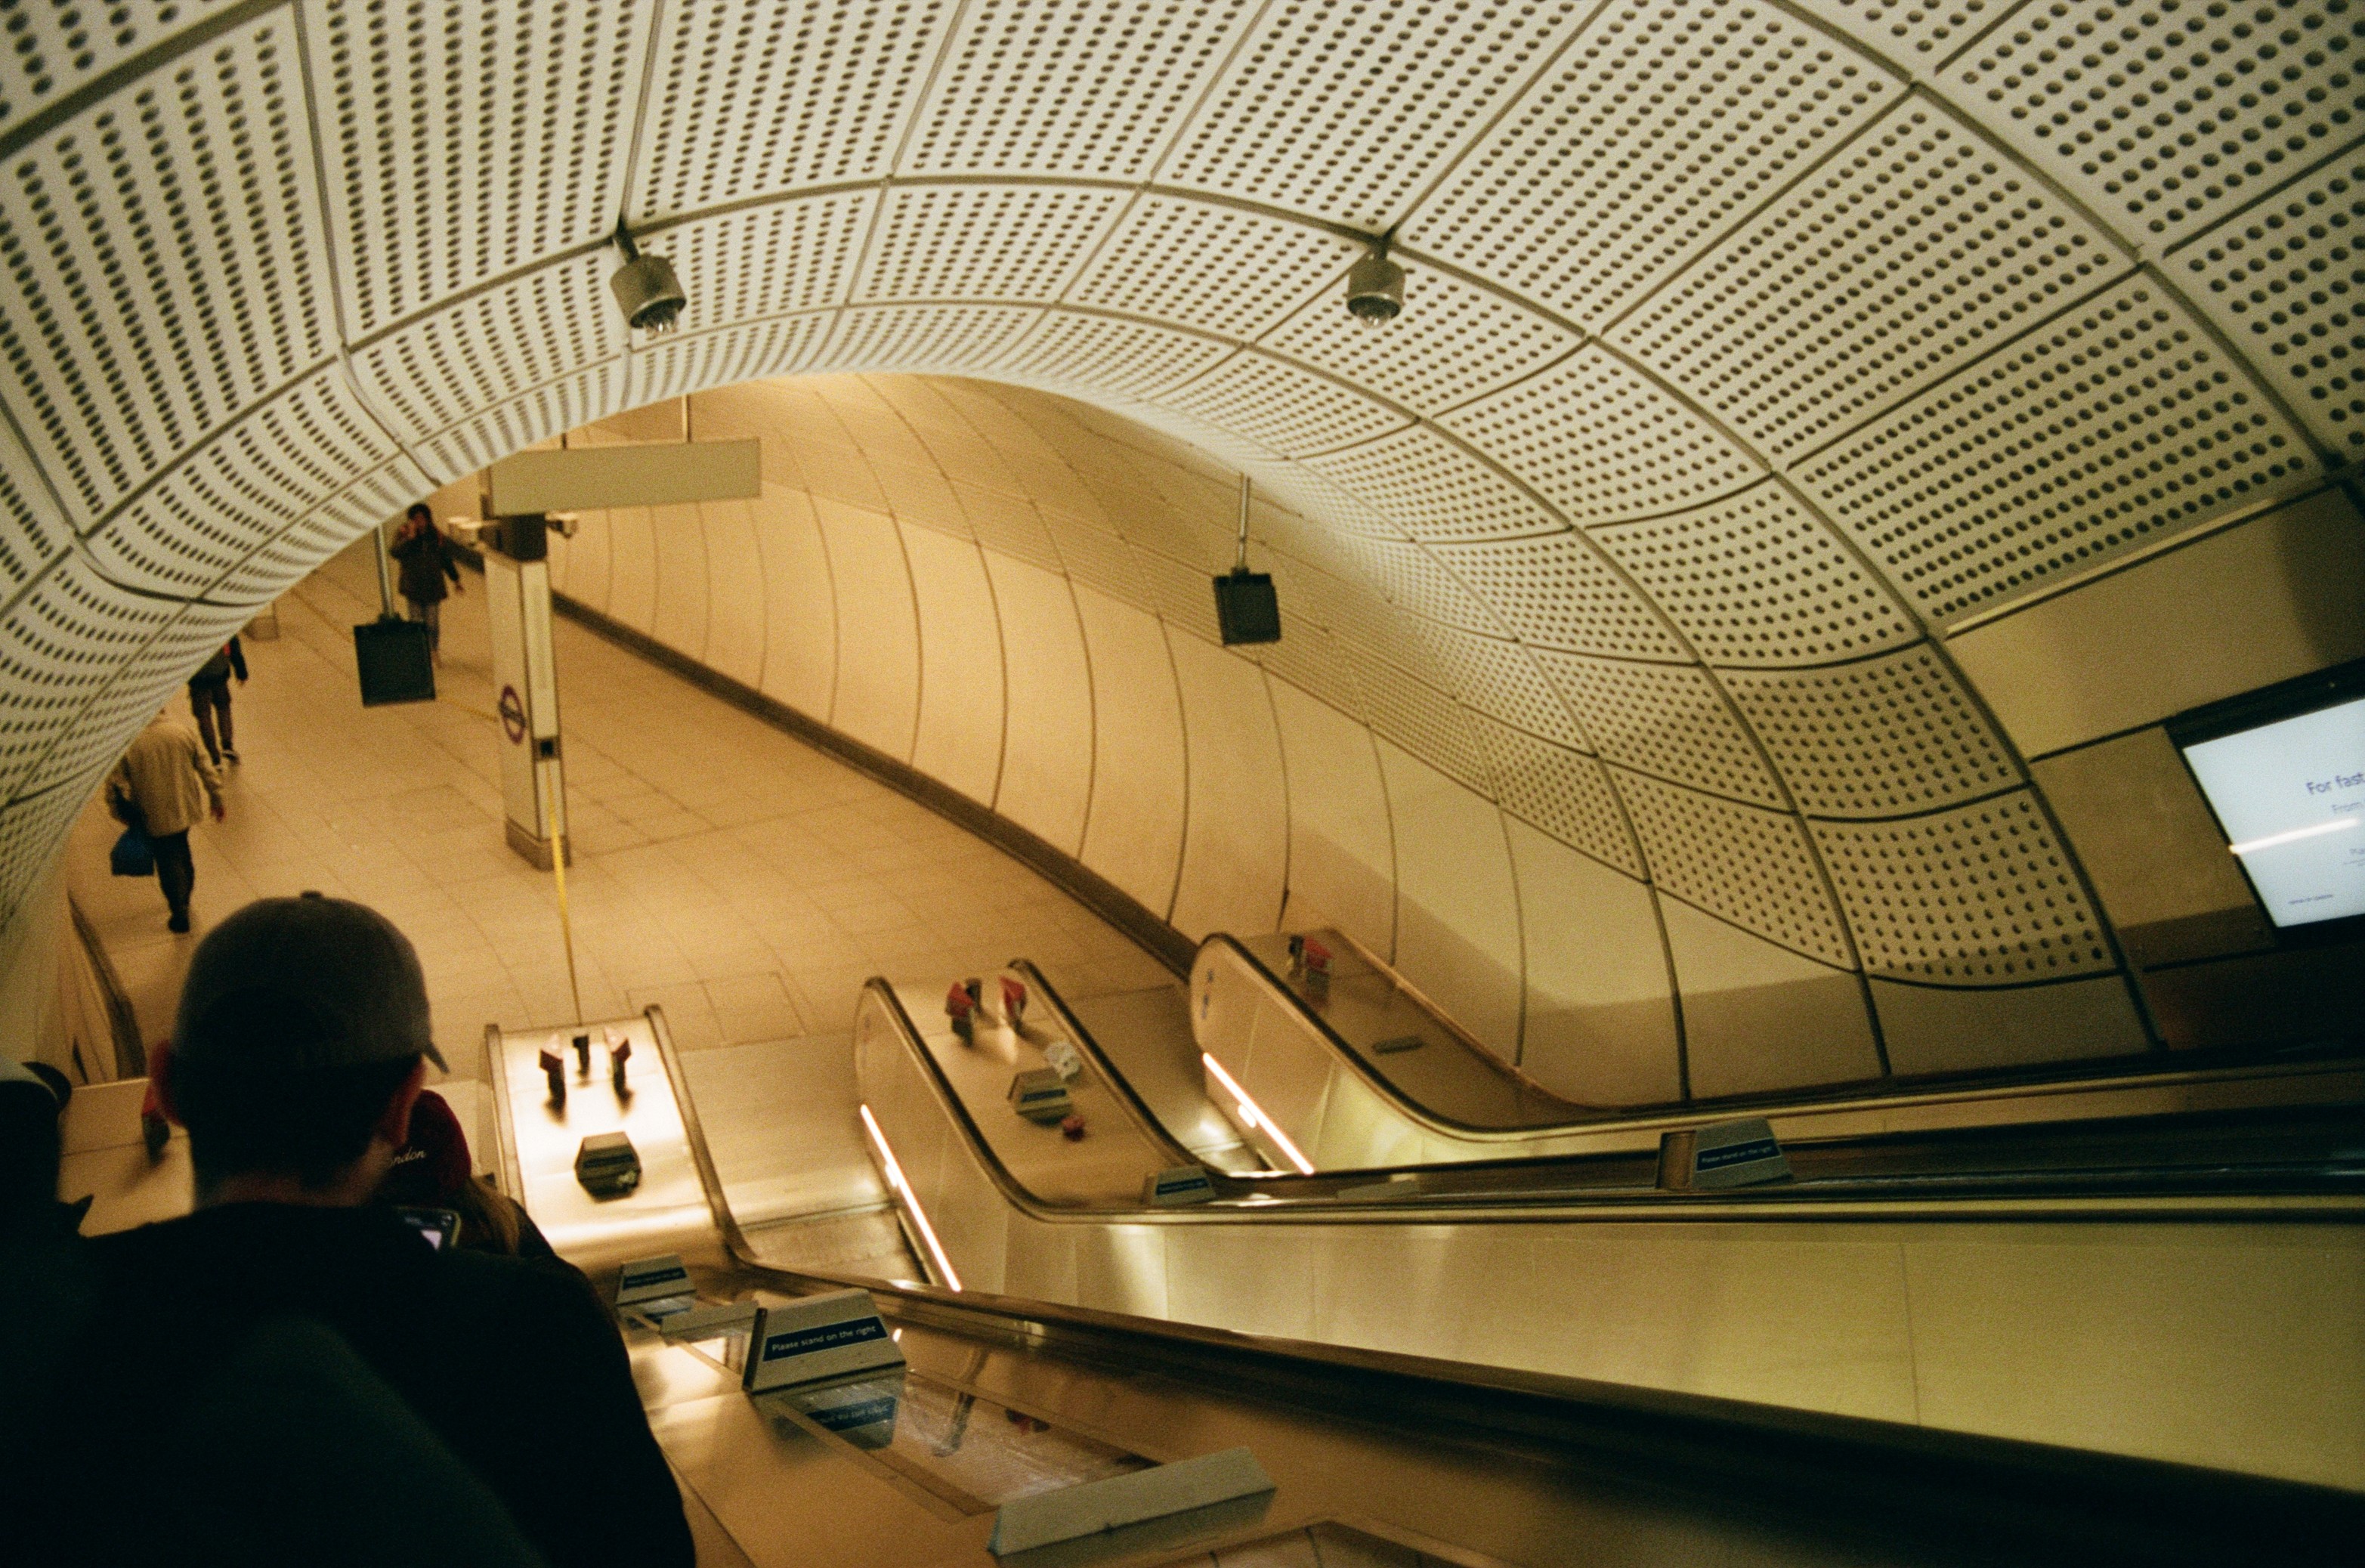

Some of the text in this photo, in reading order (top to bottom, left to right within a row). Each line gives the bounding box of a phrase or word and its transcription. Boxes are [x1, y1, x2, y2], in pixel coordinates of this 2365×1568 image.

[2306, 781, 2332, 795] For
[771, 1341, 799, 1352] Please
[800, 1335, 824, 1347] stand
[839, 1329, 853, 1338] the
[855, 1325, 876, 1336] right
